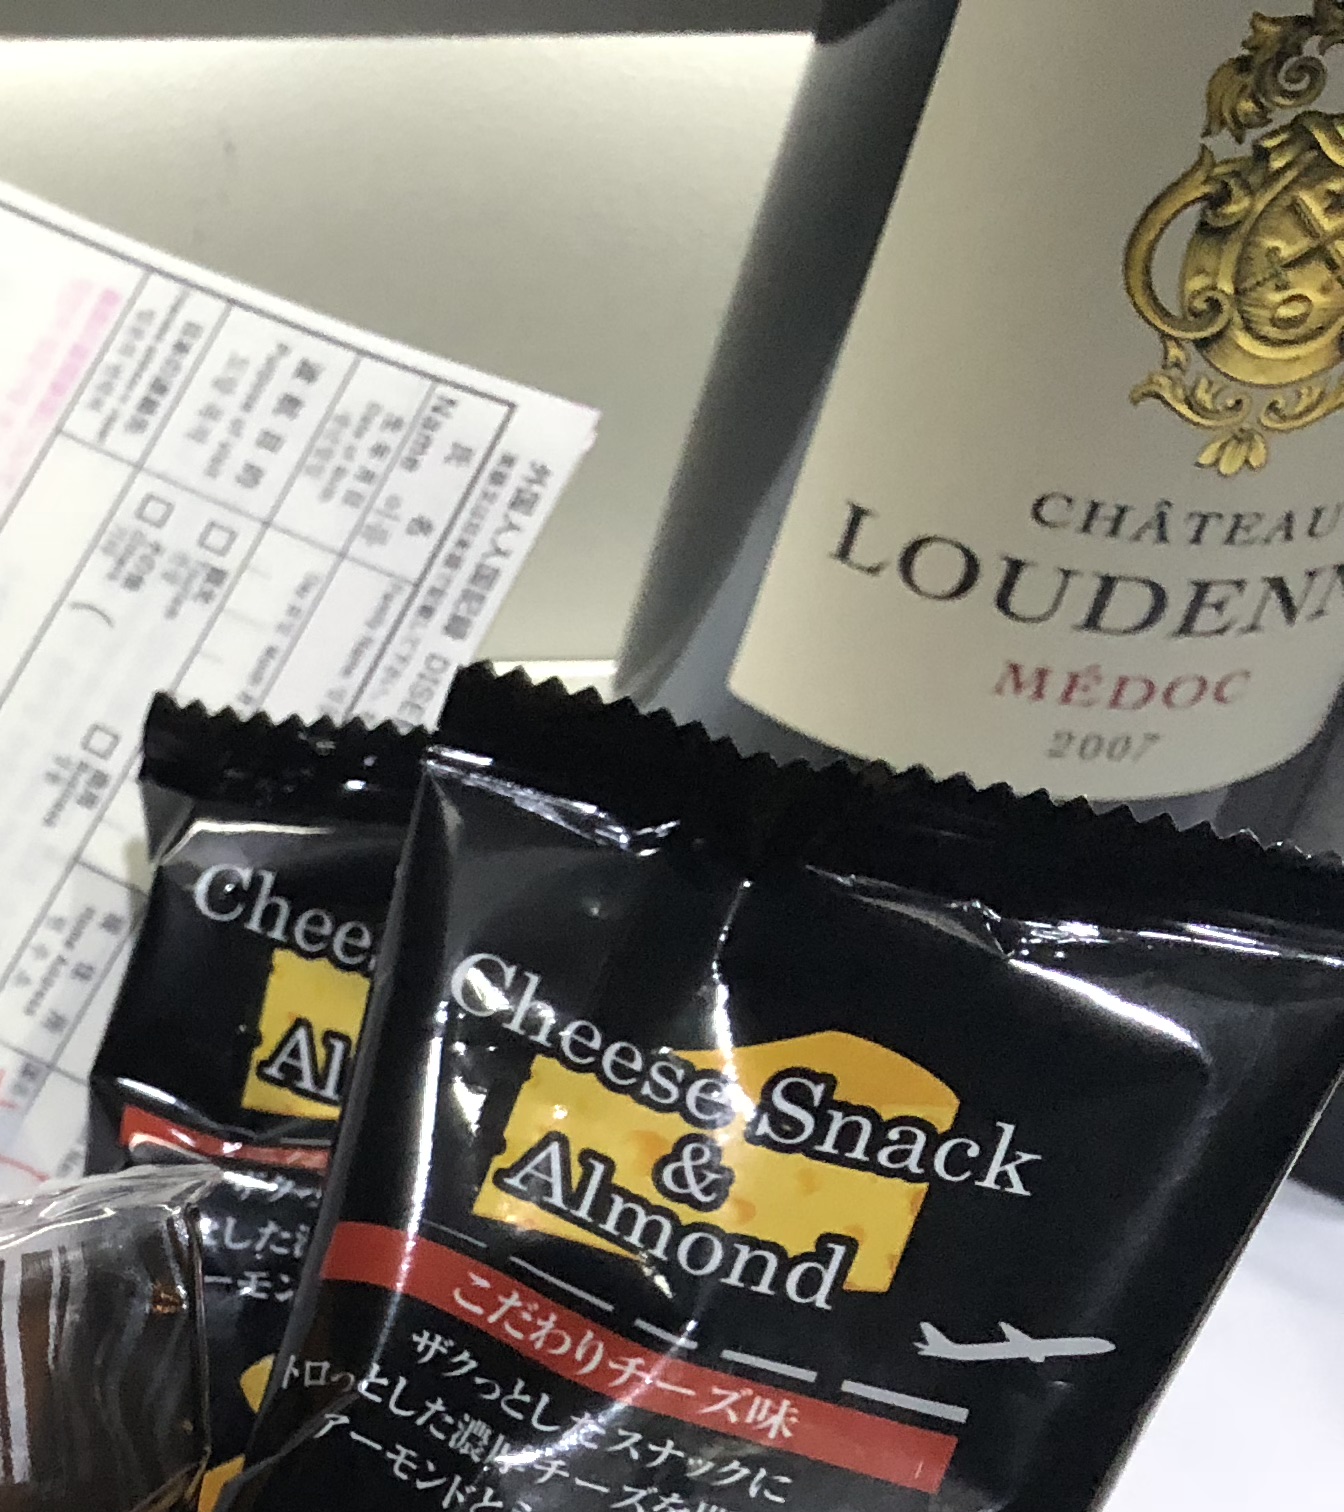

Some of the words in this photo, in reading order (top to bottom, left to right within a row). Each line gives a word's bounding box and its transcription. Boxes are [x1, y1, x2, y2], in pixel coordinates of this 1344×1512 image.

[398, 390, 461, 478] Name
[1031, 490, 1344, 548] CHÂTEAU
[993, 657, 1252, 712] MÉDOC
[1047, 729, 1161, 762] 2007
[264, 1024, 342, 1101] Al
[449, 953, 737, 1124] Cheese
[752, 1075, 1042, 1197] Snack
[662, 1142, 735, 1203] &
[503, 1137, 847, 1310] Almond
[449, 1270, 801, 1440] こだわりチーズ味
[411, 1329, 788, 1505] ザクっとしたスナックに
